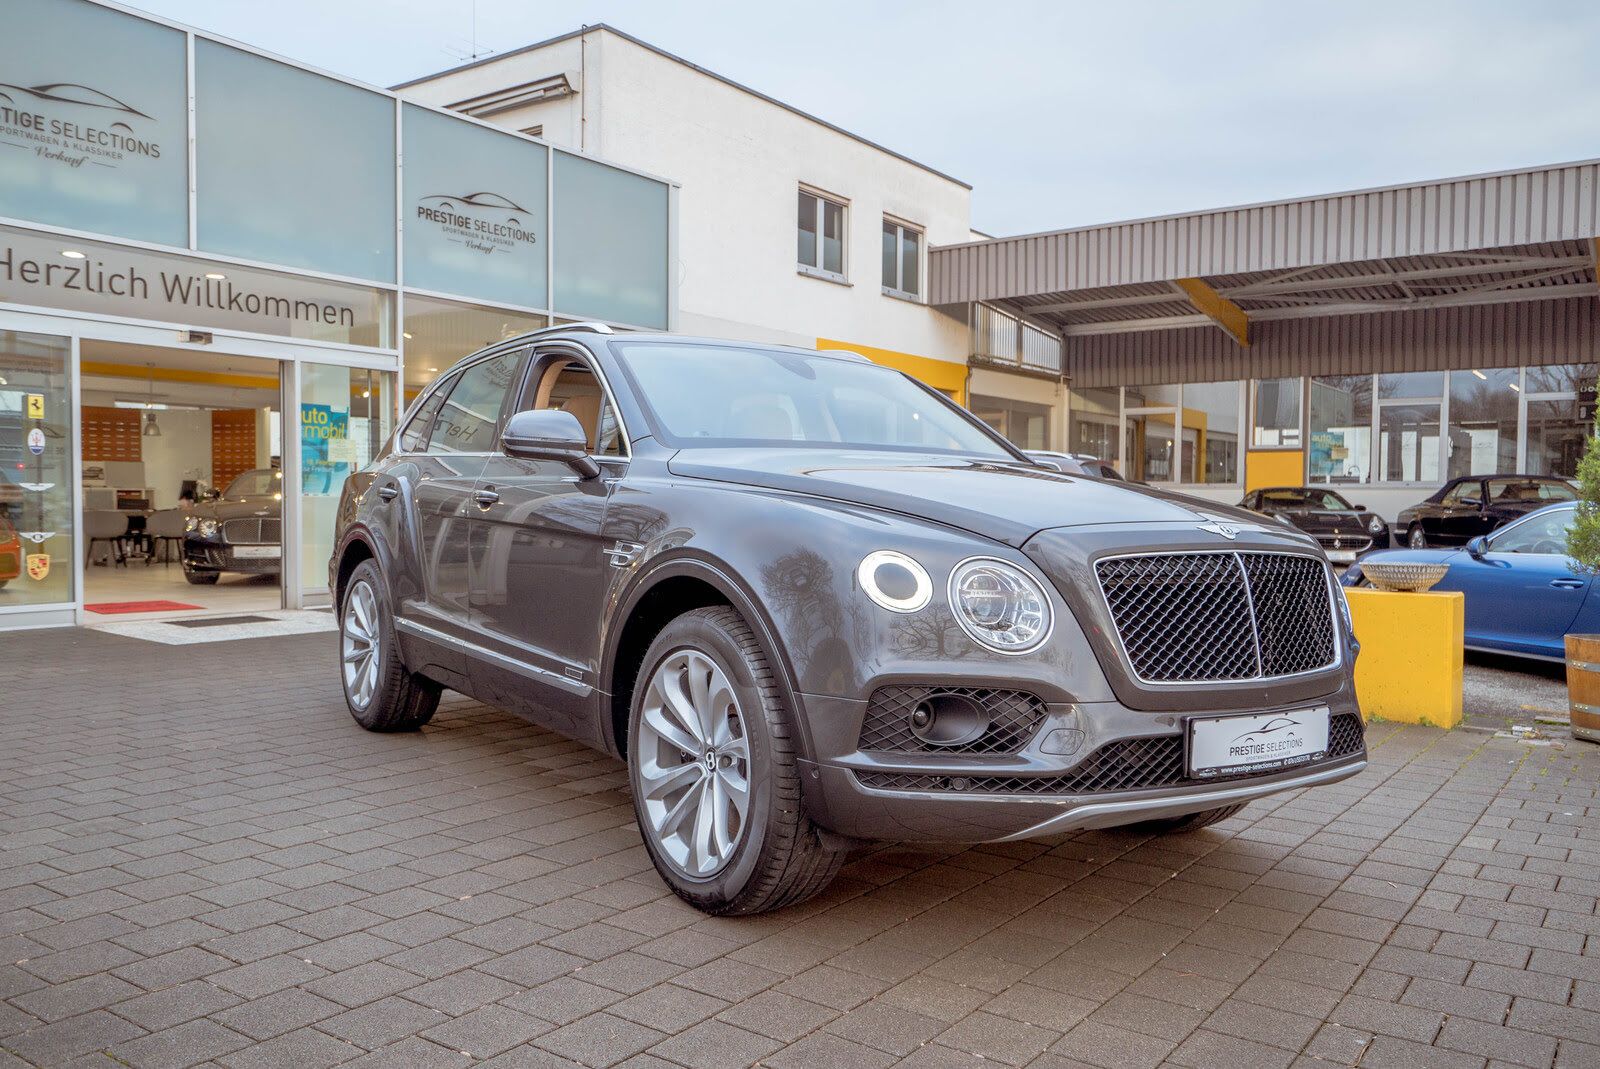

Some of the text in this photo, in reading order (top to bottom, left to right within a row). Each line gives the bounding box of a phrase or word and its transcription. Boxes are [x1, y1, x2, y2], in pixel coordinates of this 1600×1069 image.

[0, 106, 161, 159] TIGE SELECTIONS
[34, 146, 89, 168] Verkauf
[73, 143, 124, 160] KLASSIKER
[417, 206, 536, 244] PRESTIGE SELECTIONS
[0, 248, 355, 328] Herzlich Willkommen
[301, 407, 328, 424] uto
[304, 422, 346, 440] mobil
[1229, 743, 1265, 757] PRESTIGE
[1266, 738, 1303, 753] SELECTIONS
